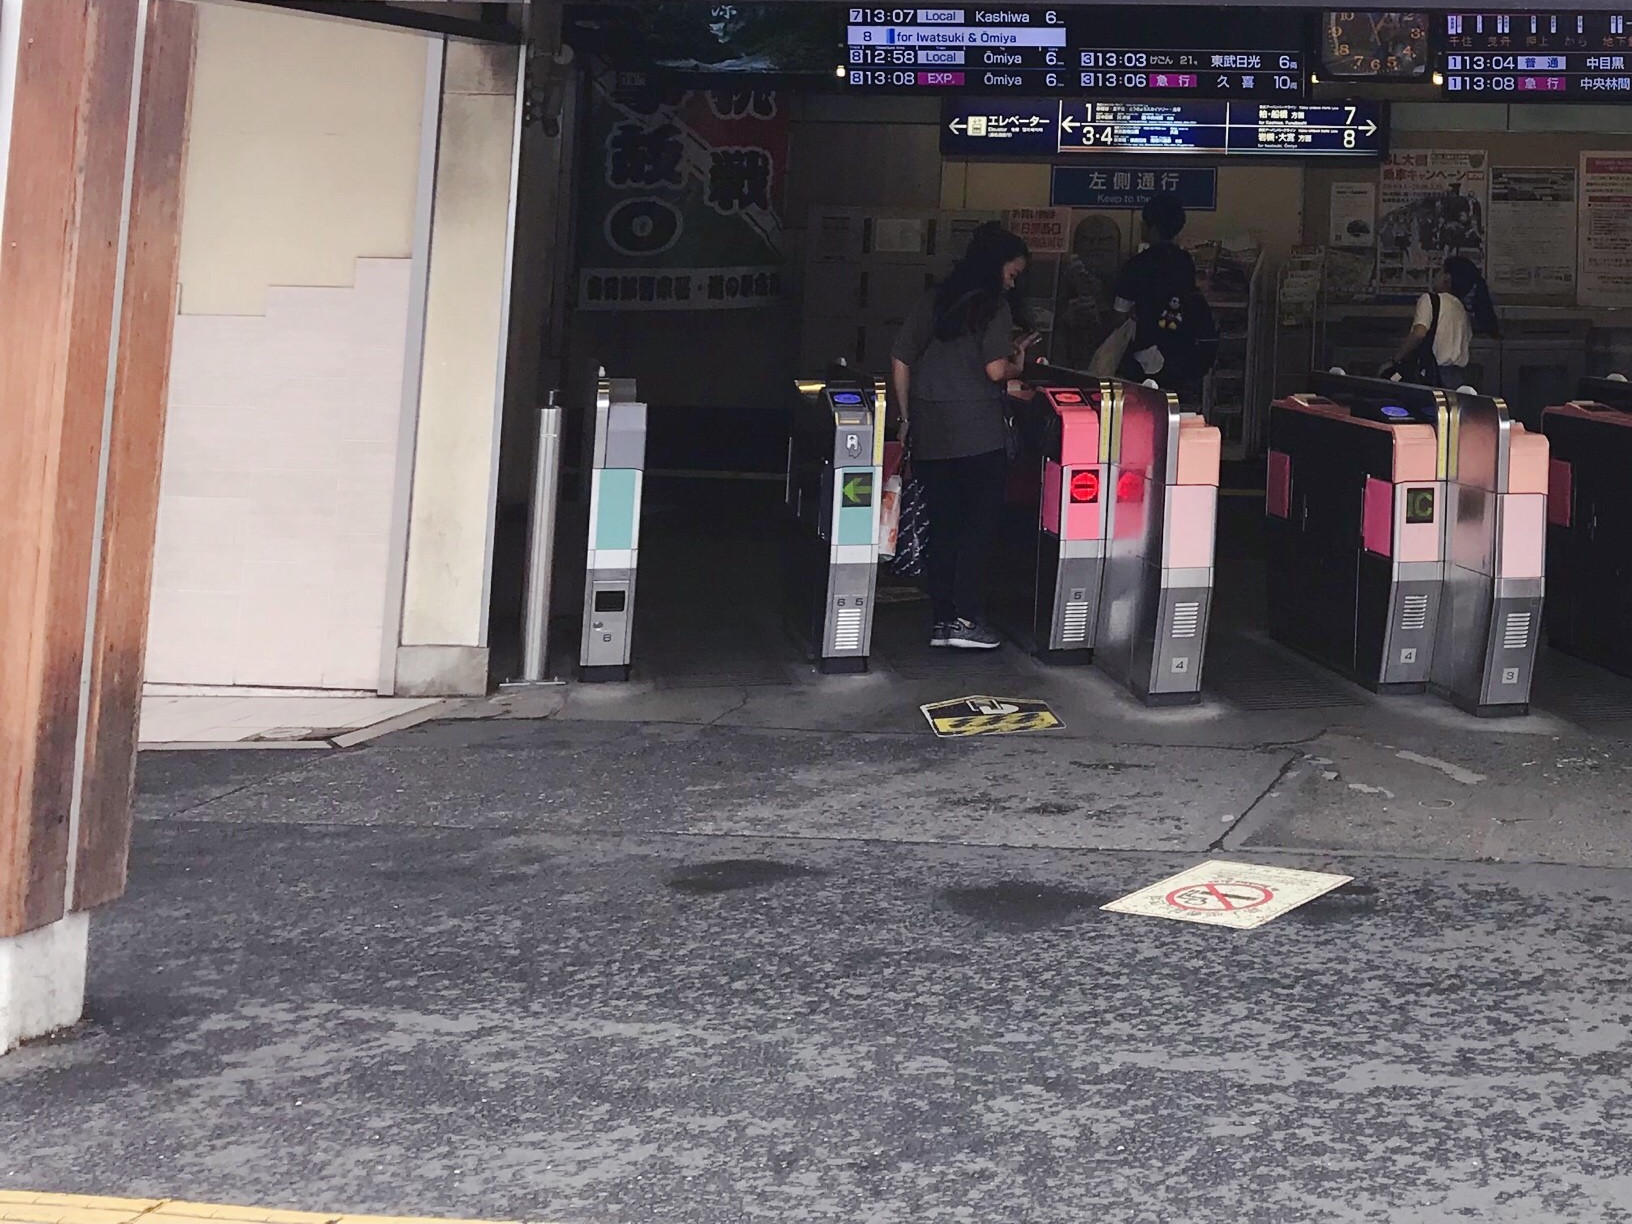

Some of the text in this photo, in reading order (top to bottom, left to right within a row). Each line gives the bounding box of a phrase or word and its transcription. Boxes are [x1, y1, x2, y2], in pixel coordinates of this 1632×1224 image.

[852, 9, 1057, 24] 7 13:07 Local Kashiwa 6
[863, 32, 872, 42] 8
[897, 32, 913, 42] for
[917, 32, 965, 43] Iwatsuki
[968, 33, 977, 43] &
[853, 51, 860, 62] 8
[866, 50, 915, 63] 12:58
[926, 52, 956, 62] Local
[1046, 52, 1057, 65] 6
[1083, 54, 1092, 66] 3
[1095, 54, 1147, 66] 13:03
[1211, 55, 1261, 68] 東武日光
[1464, 57, 1515, 69] 13:04
[1525, 57, 1559, 68] 普通
[1587, 57, 1625, 69] 中目黒
[853, 73, 860, 83] 8
[866, 72, 915, 85] 13:08
[927, 73, 955, 84] EXP.
[1046, 73, 1057, 87] 6
[1083, 74, 1092, 86] 3
[1095, 74, 1147, 87] 13:06
[1156, 75, 1191, 87] 急行
[1217, 76, 1254, 89] 久喜
[1464, 77, 1515, 90] 13:08
[1525, 78, 1559, 89] 急行
[1580, 78, 1630, 91] 中央林間
[1085, 104, 1092, 122] 1
[1344, 107, 1356, 125] 7
[988, 115, 1050, 127] エレベーター
[1343, 130, 1355, 148] 8
[1089, 172, 1179, 192] 左側通行
[1125, 196, 1134, 204] to
[1408, 491, 1433, 519] IC
[855, 597, 863, 607] 5
[1073, 591, 1082, 600] 5
[837, 598, 845, 607] 6
[603, 633, 612, 643] 6
[1404, 651, 1413, 661] 4
[1175, 660, 1185, 670] 4
[1505, 671, 1515, 681] 3
